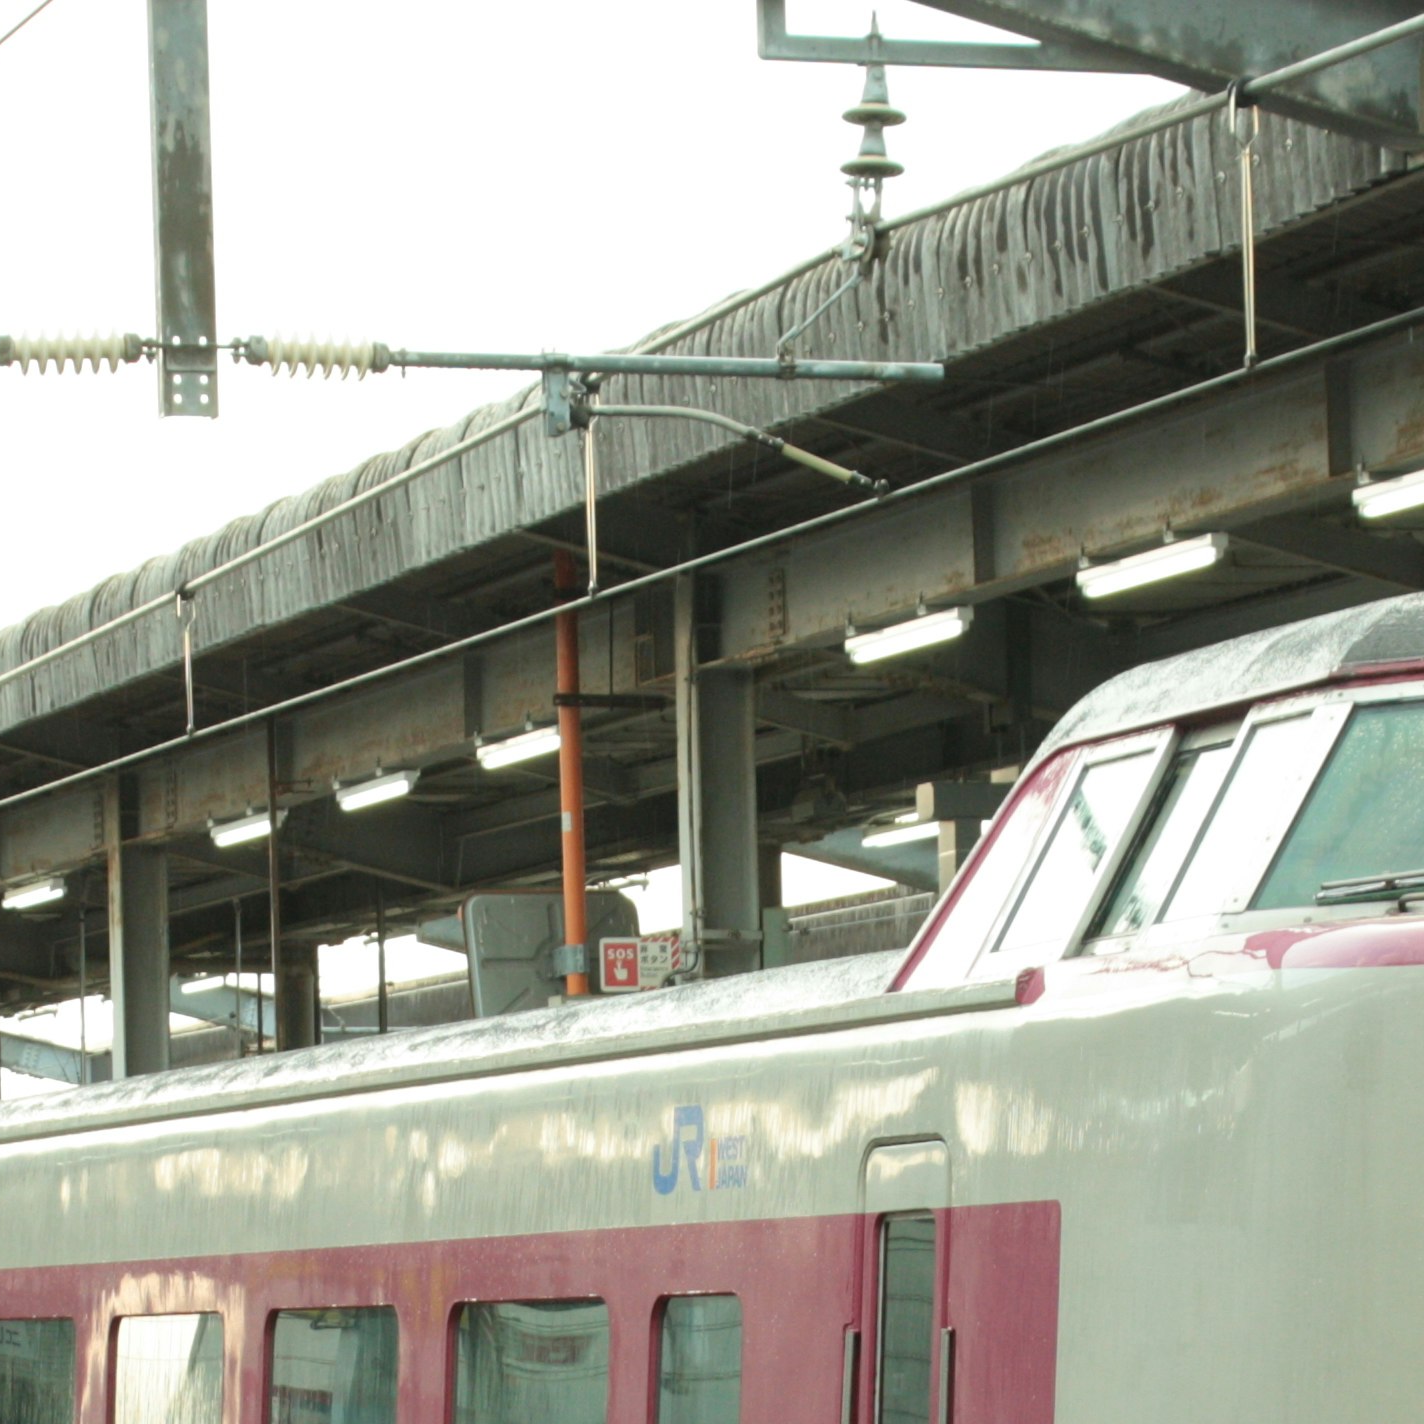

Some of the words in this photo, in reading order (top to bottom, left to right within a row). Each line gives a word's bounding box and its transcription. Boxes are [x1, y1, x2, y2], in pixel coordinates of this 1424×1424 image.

[607, 948, 634, 959] SOS
[641, 955, 668, 964] ボタン
[653, 1104, 703, 1194] JR
[717, 1135, 746, 1161] WEST
[716, 1165, 748, 1189] JAPAN
